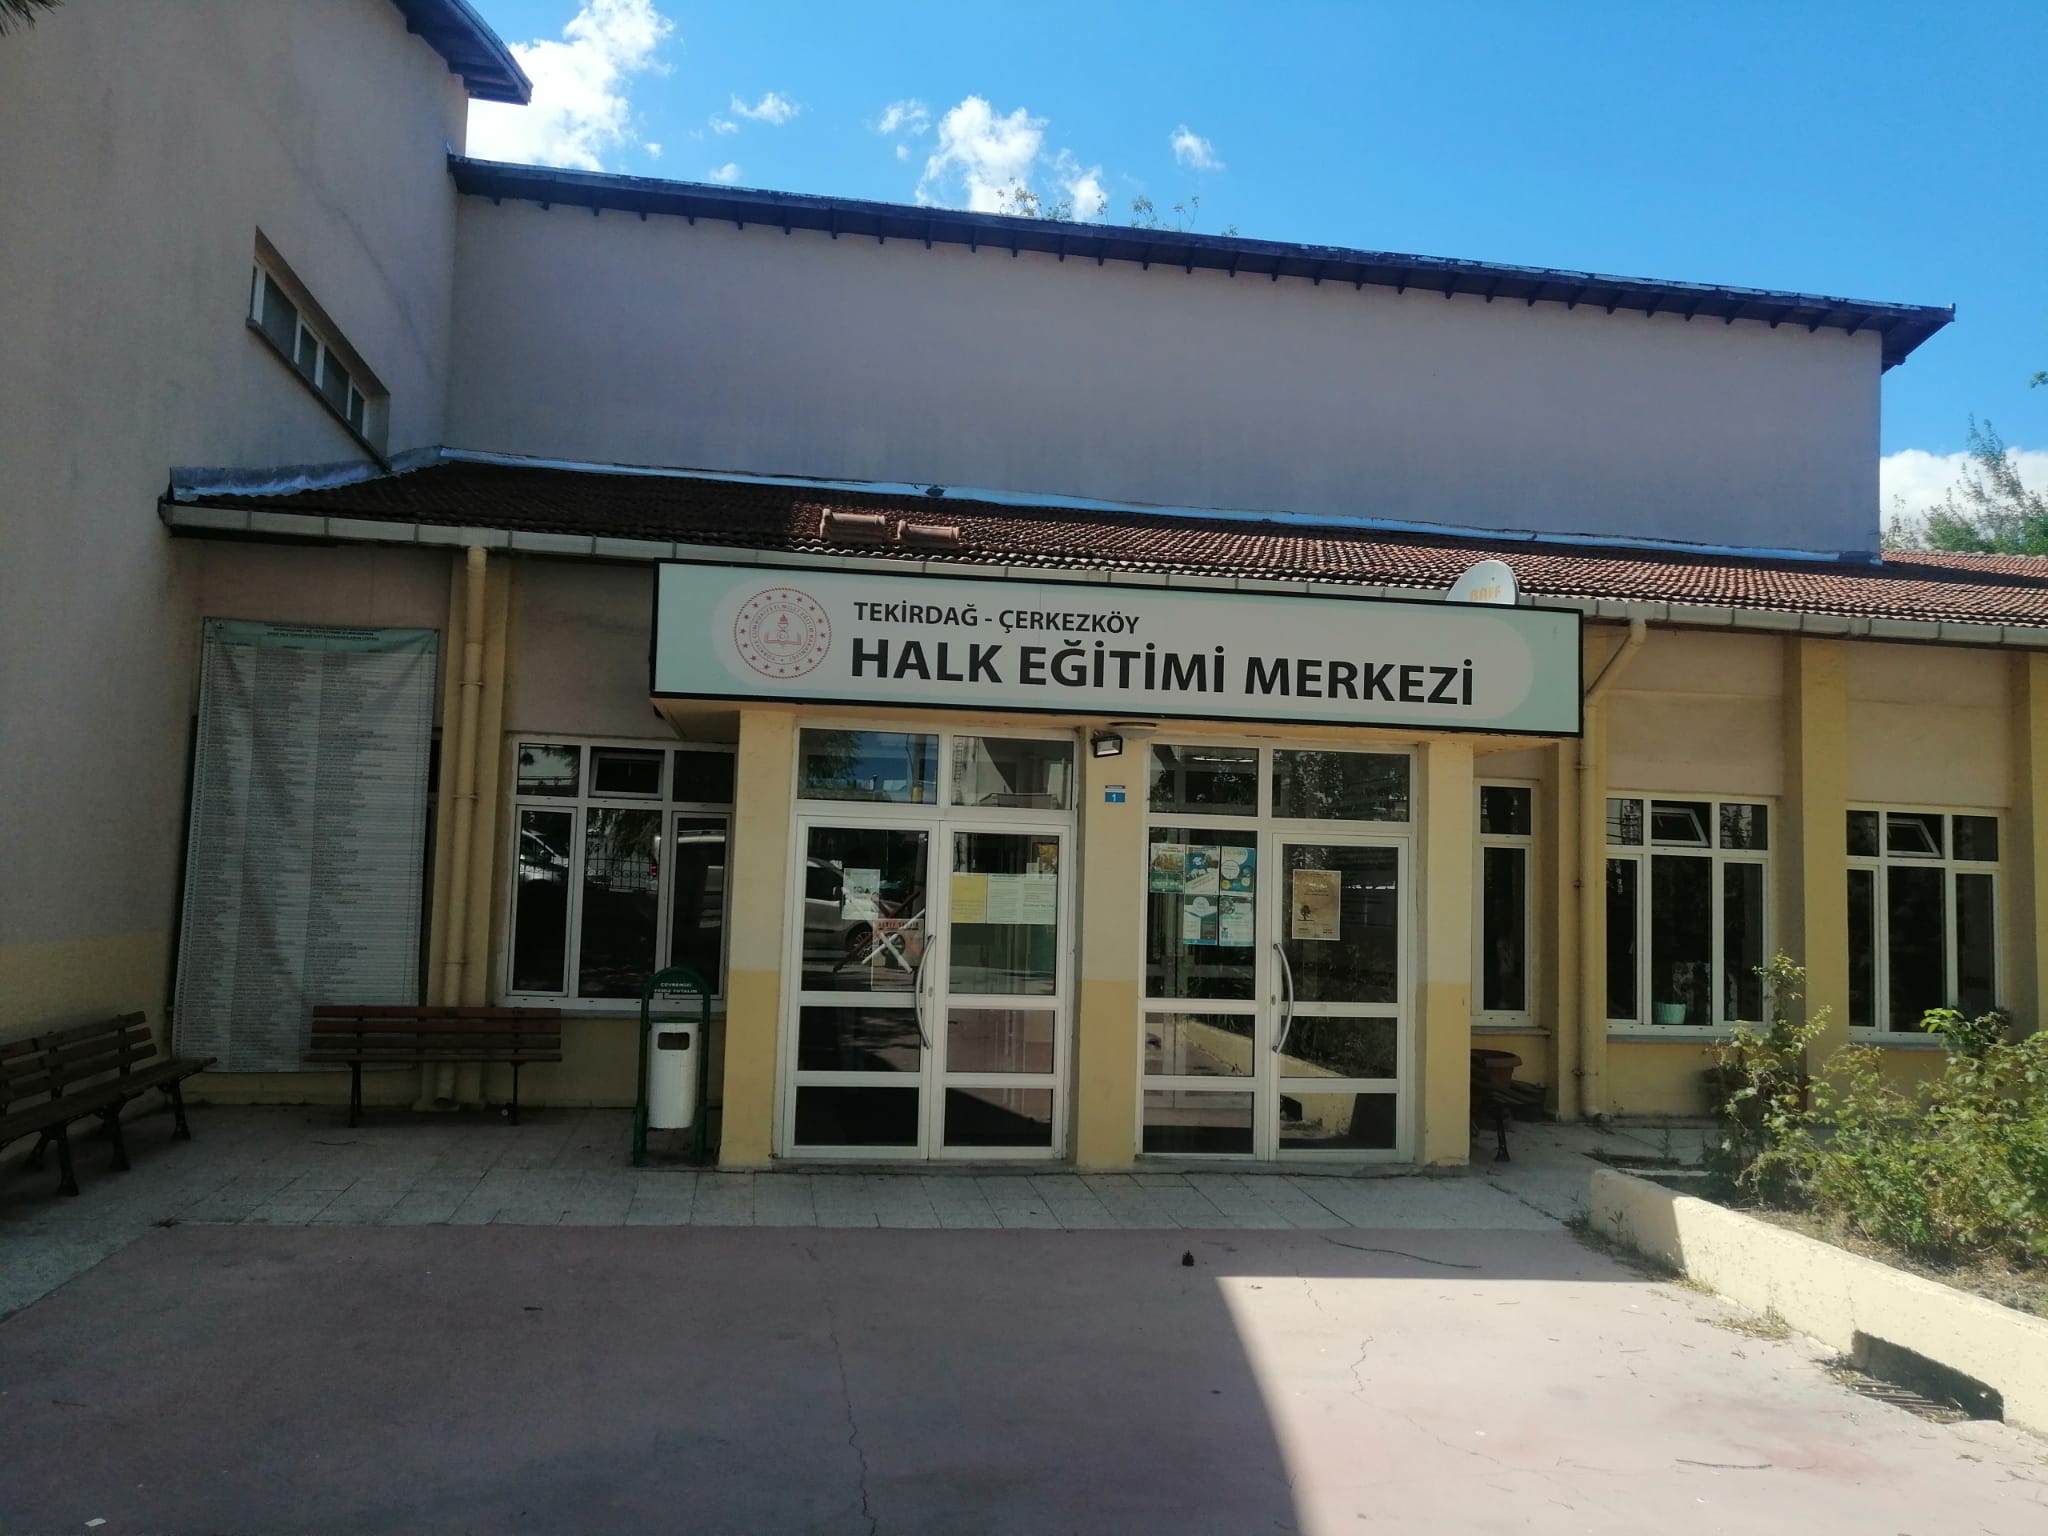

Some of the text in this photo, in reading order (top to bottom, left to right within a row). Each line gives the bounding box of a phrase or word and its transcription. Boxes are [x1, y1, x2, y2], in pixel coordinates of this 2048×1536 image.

[854, 600, 978, 627] TEKİRDAĞ
[999, 609, 1140, 634] ÇERKEZKÖY
[852, 638, 1473, 706] HALK EĞİTİMİ MERKEZİ
